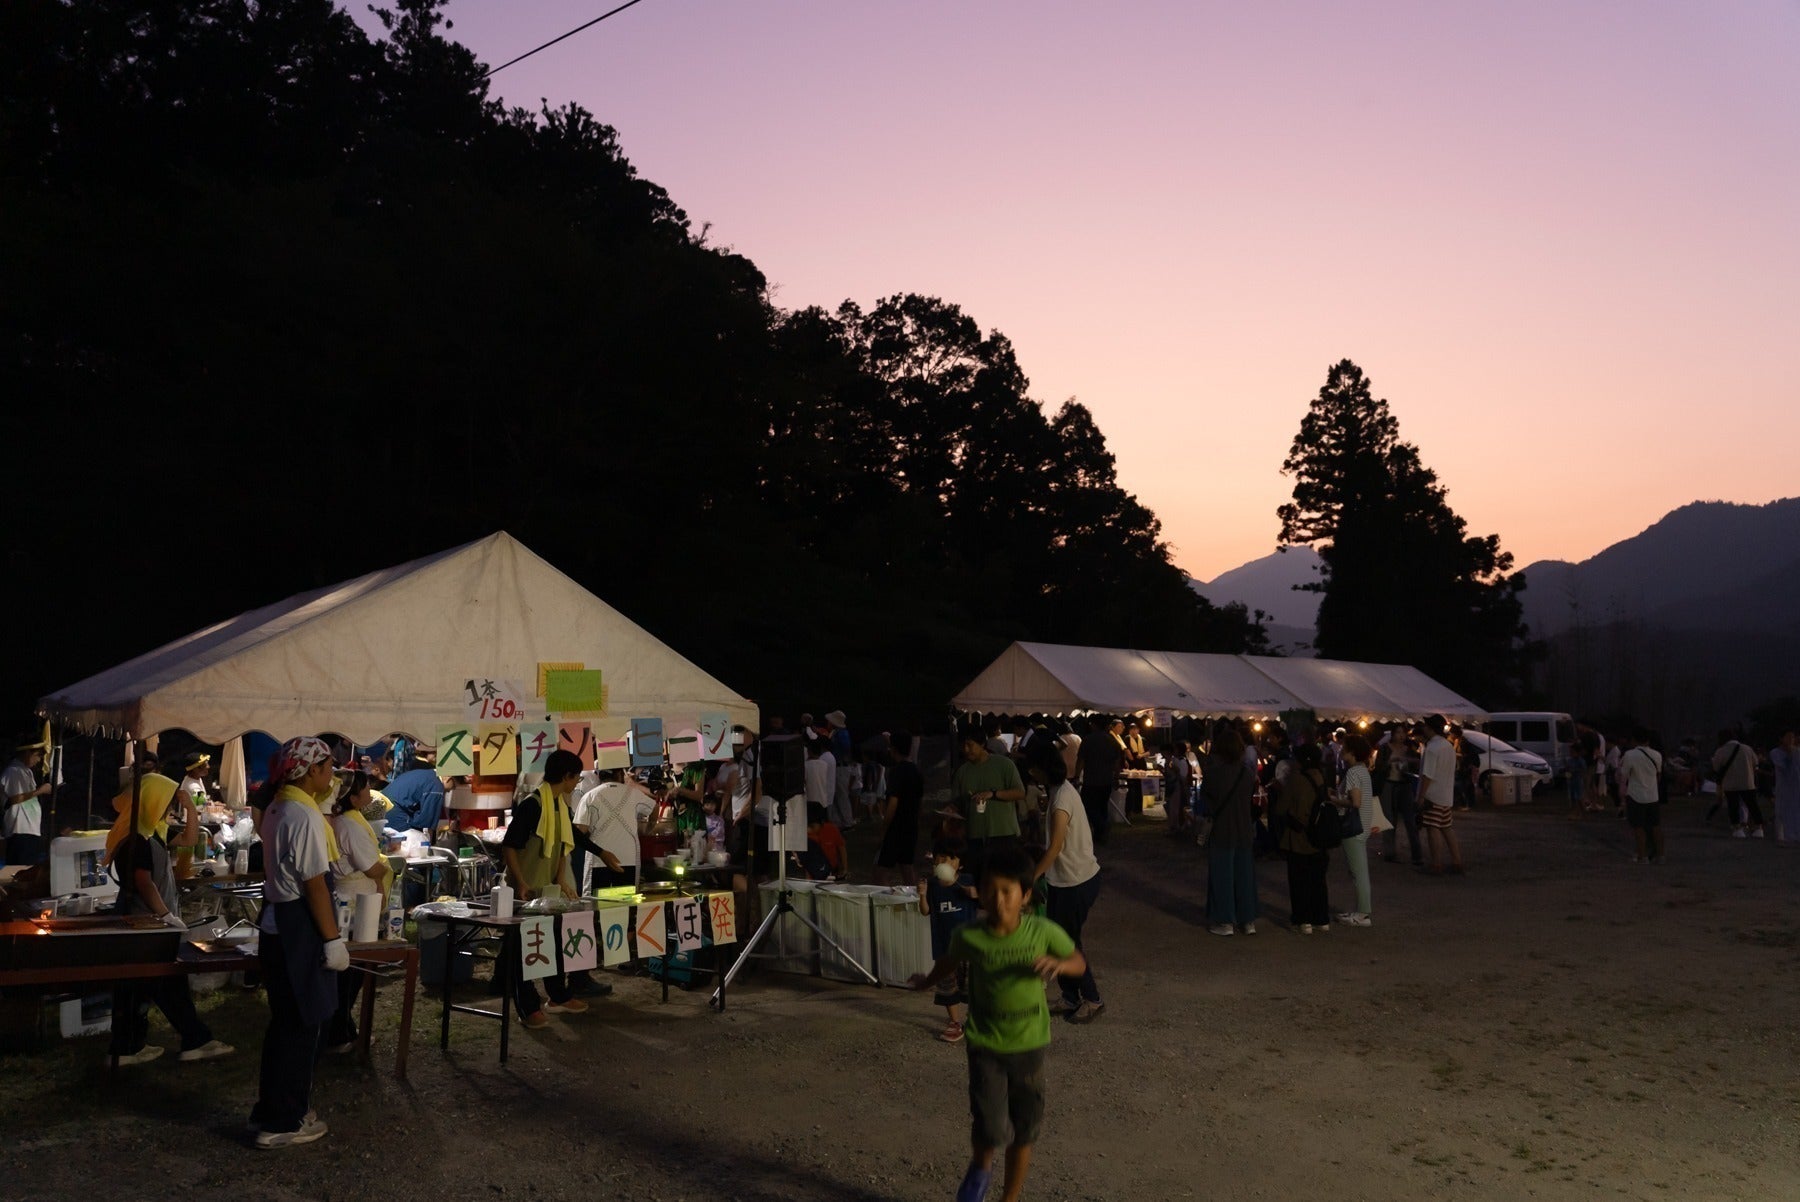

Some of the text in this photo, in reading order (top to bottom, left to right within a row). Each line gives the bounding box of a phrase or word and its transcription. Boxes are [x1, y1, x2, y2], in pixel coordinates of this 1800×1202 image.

[465, 679, 502, 706] 1本
[480, 698, 525, 720] 150円
[438, 720, 728, 767] スダチソーセージ
